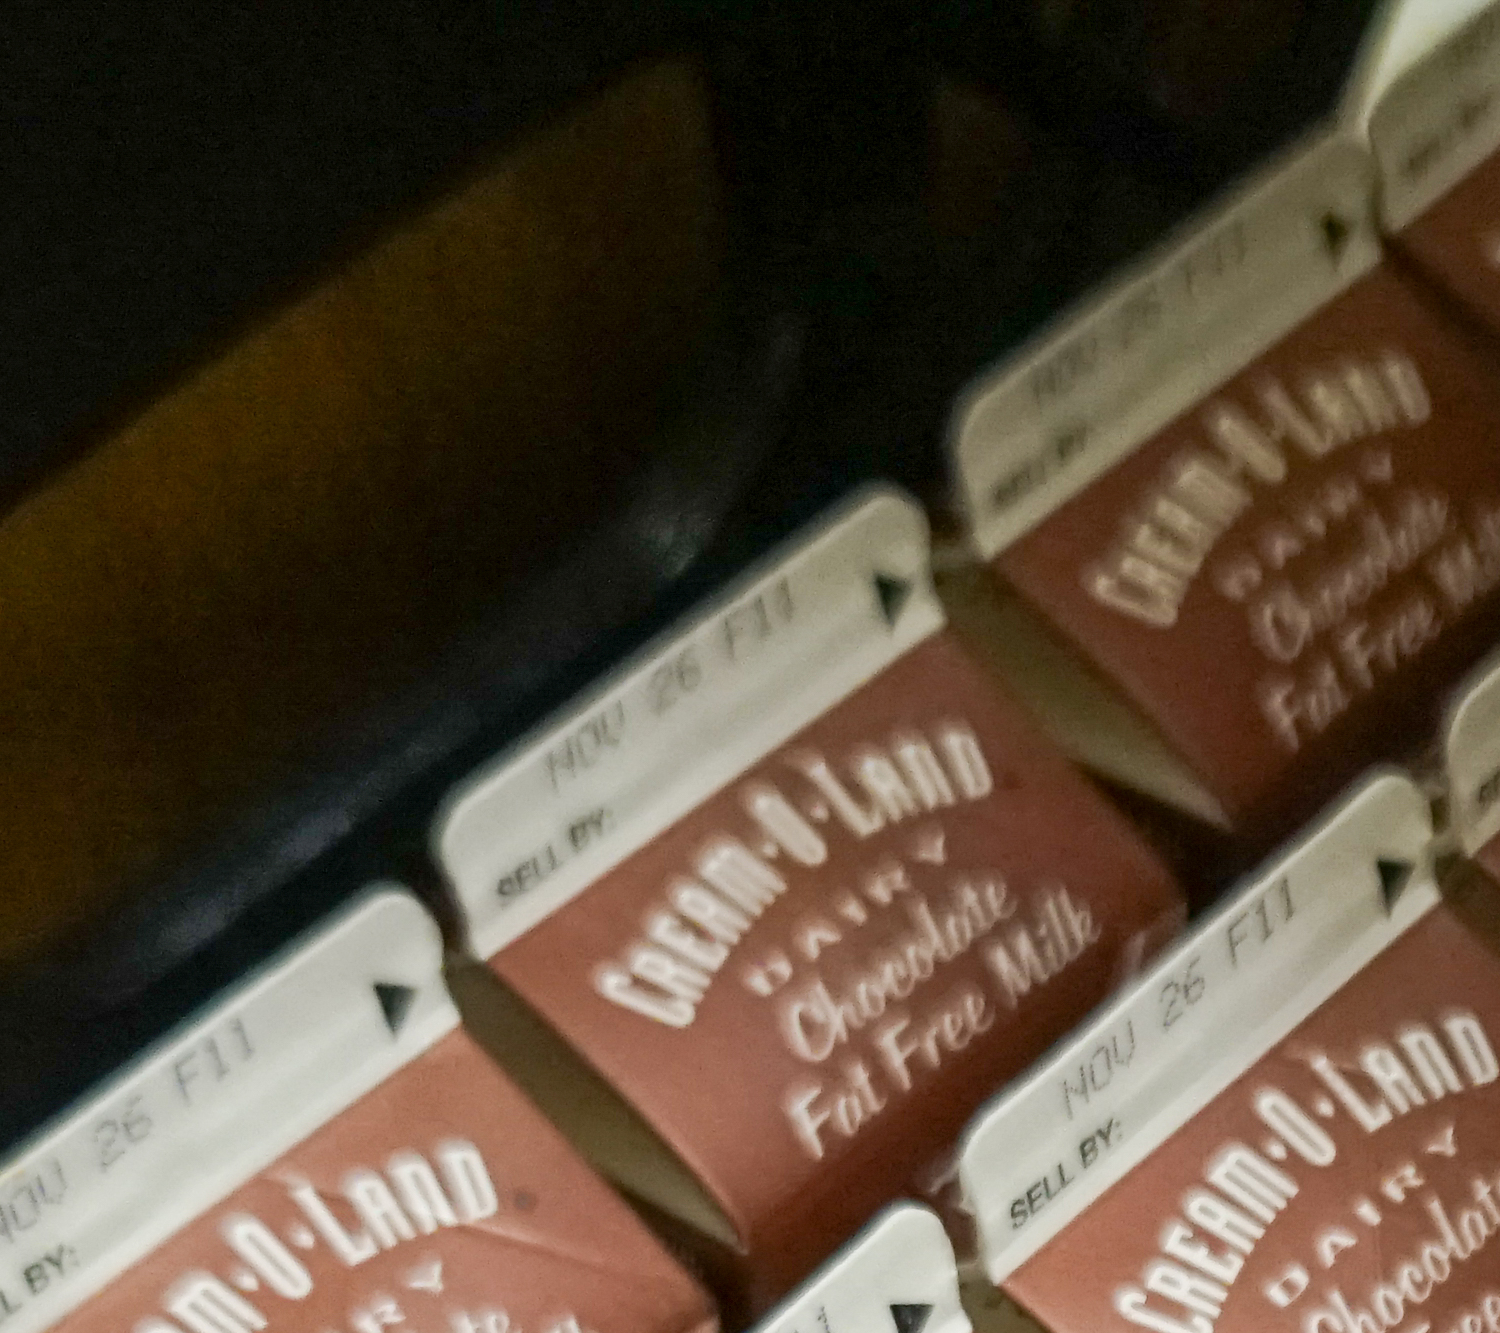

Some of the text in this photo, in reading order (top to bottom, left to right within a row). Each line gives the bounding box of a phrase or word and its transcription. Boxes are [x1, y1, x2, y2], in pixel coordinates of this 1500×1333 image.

[783, 867, 1019, 1063] Chocolate
[785, 885, 1102, 1159] Fat Free Milk
[1009, 1116, 1125, 1229] SELL BY:
